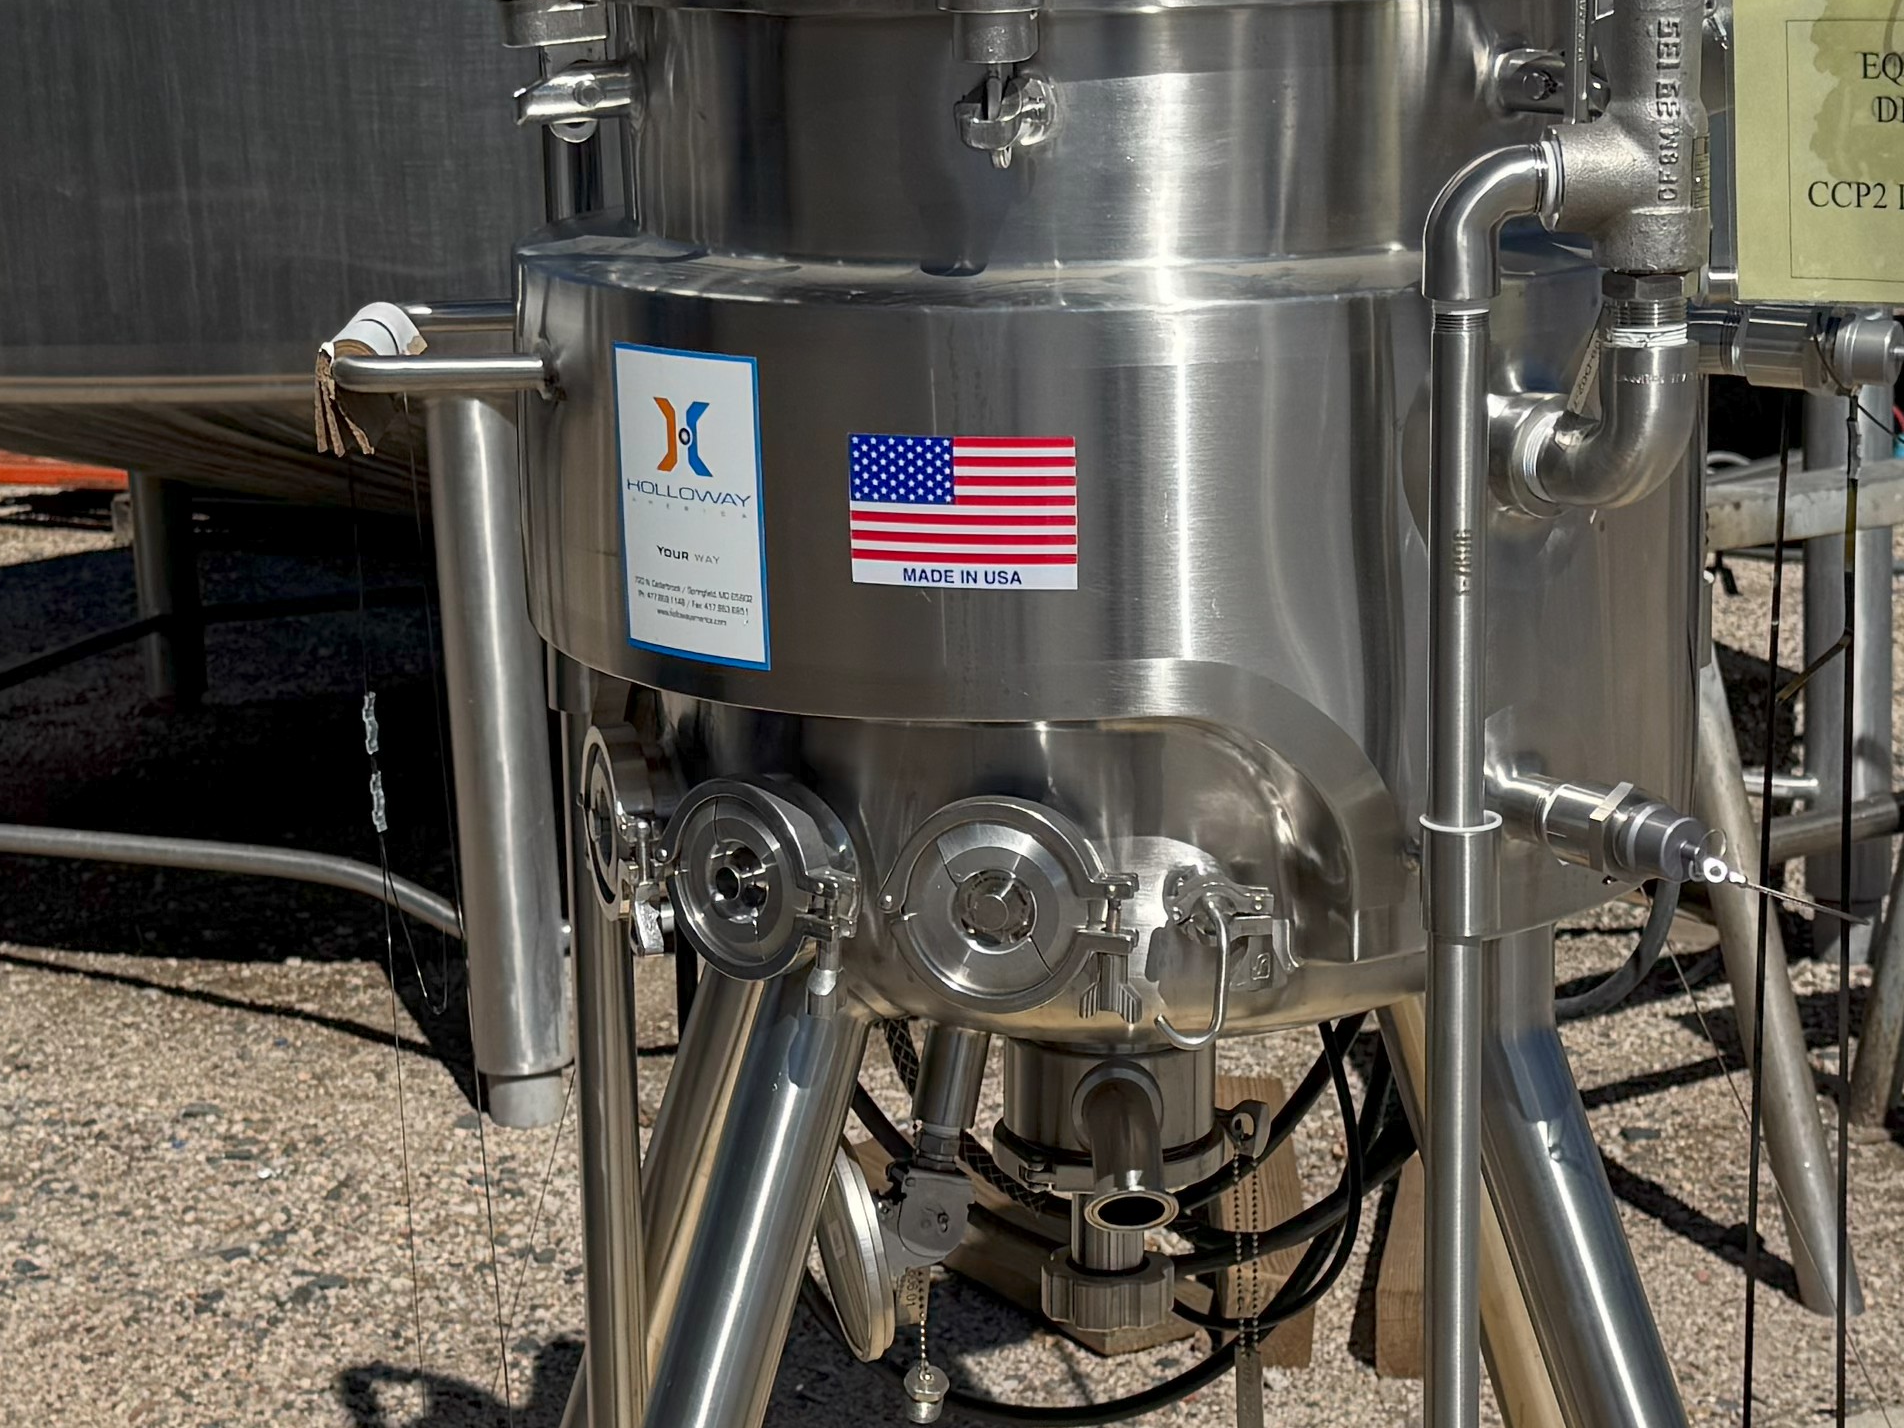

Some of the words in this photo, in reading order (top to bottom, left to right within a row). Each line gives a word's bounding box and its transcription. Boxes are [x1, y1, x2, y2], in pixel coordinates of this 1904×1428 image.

[1807, 181, 1887, 210] CCP2
[627, 478, 751, 507] HOLLOWAY
[656, 545, 689, 561] YOUR
[694, 554, 720, 565] WAY
[902, 567, 955, 585] MADE
[961, 568, 978, 585] IN
[982, 568, 1023, 586] USA
